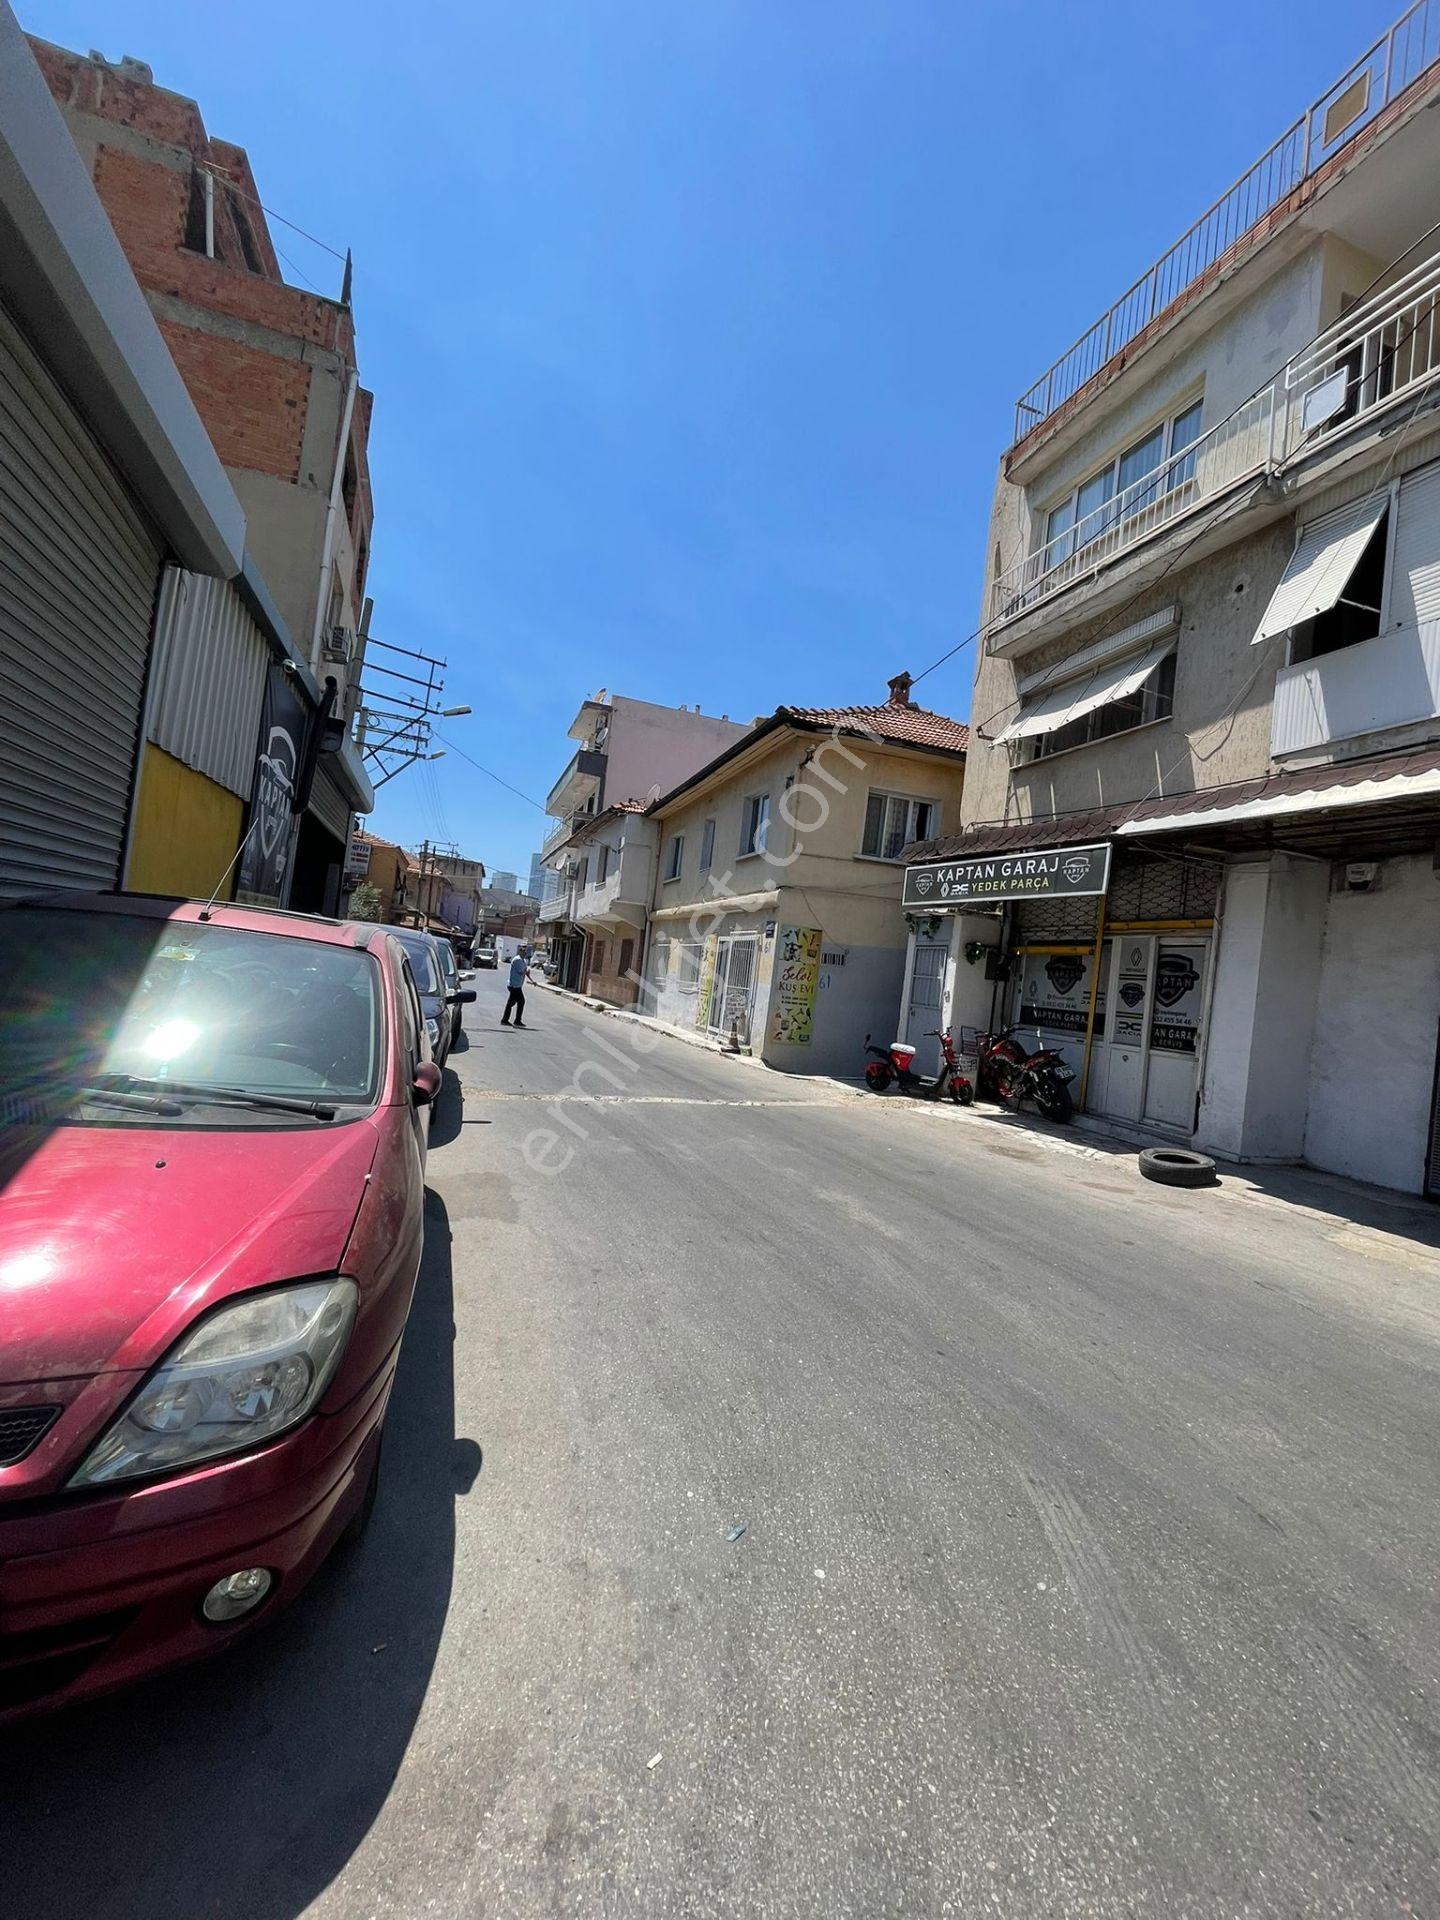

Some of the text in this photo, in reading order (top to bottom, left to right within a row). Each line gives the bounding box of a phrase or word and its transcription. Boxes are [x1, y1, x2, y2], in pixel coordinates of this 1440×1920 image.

[936, 857, 1059, 882] KAPTAN GARAJ
[971, 877, 1050, 892] YEDEK PARÇA
[778, 981, 798, 994] KUŞ
[818, 974, 831, 990] 61
